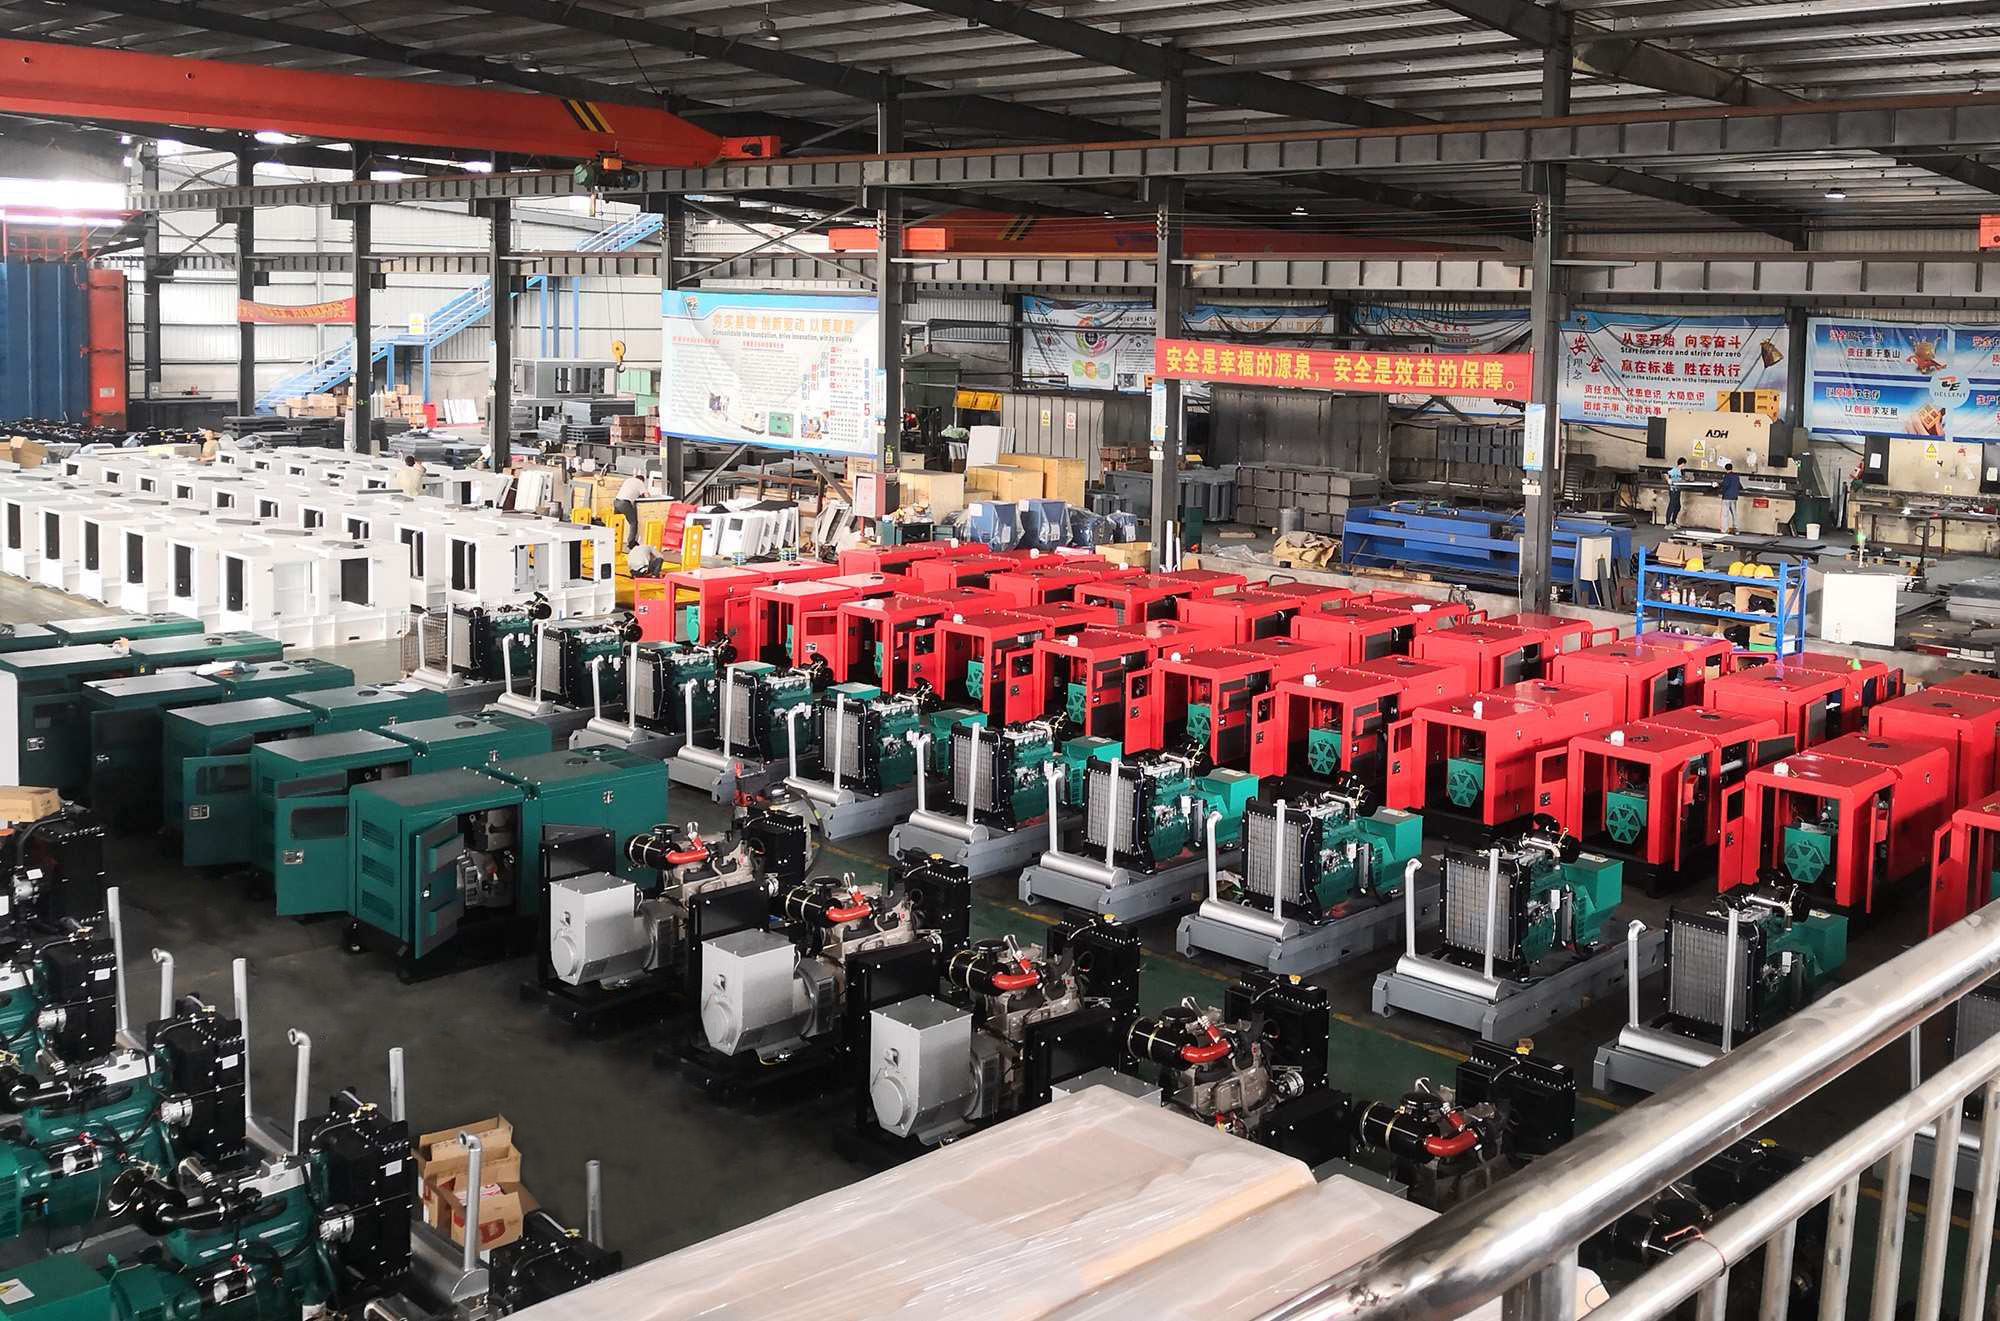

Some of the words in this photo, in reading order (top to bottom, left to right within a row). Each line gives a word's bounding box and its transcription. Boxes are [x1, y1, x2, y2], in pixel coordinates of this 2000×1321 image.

[1621, 332, 1675, 348] 从零开始
[1685, 335, 1741, 349] 向零奋斗
[1639, 347, 1656, 355] from
[1621, 359, 1675, 375] 赢在标准
[1684, 362, 1741, 377] 胜在执行
[1705, 429, 1729, 439] ADH
